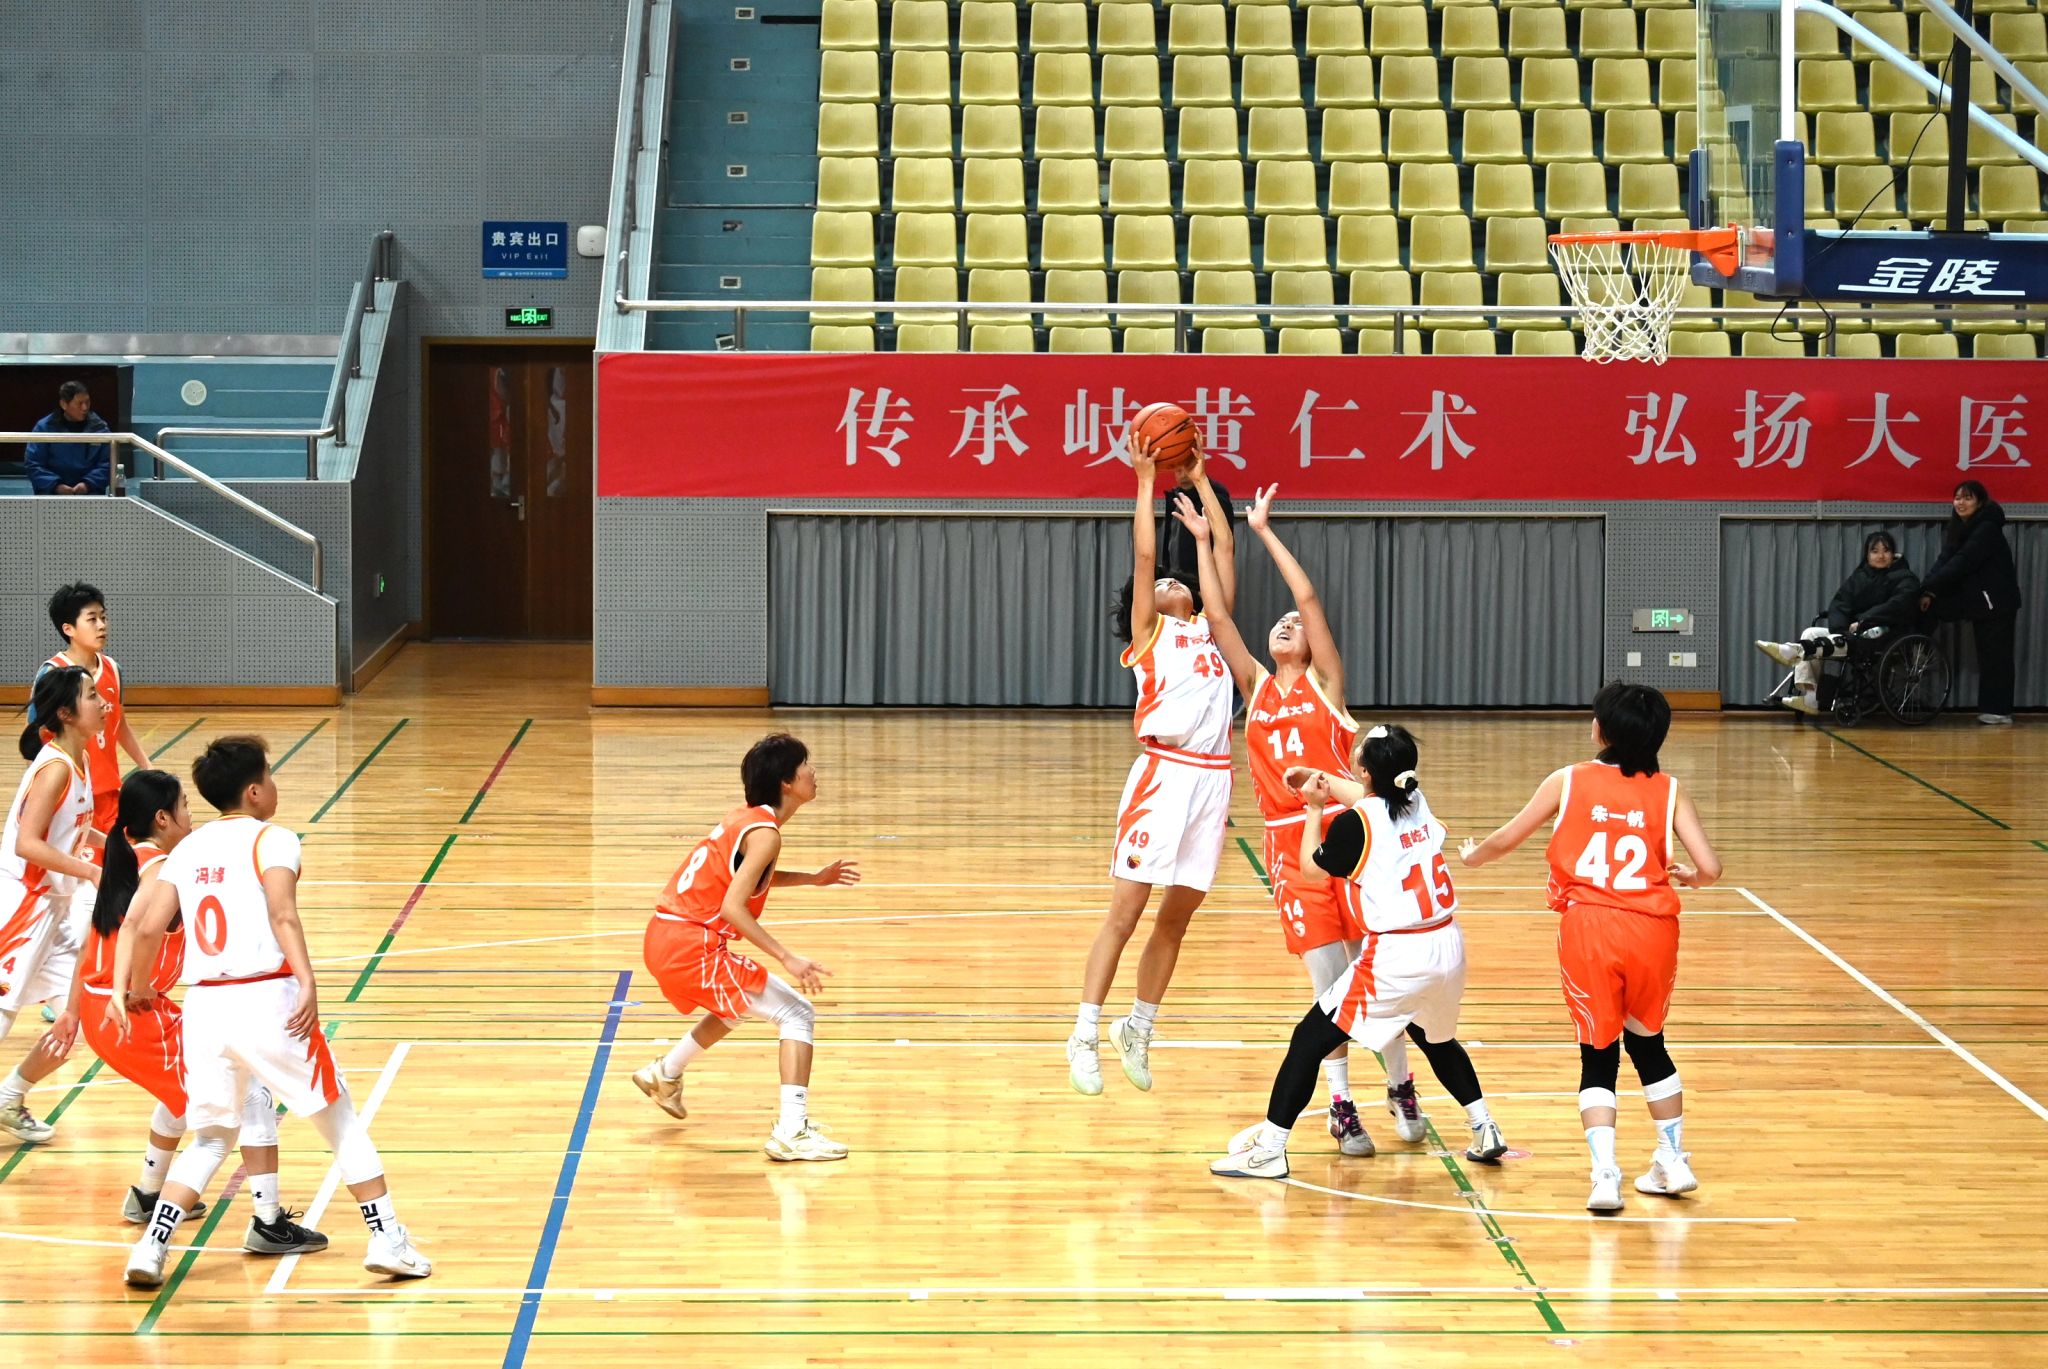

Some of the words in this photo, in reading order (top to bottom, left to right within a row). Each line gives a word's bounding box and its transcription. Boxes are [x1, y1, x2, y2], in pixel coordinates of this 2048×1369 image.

[492, 232, 559, 246] 贵宾出口
[1838, 257, 2026, 296] 金陵
[835, 384, 1478, 470] 传承岐黄仁术
[1625, 389, 2031, 471] 弘扬大医
[1193, 652, 1224, 678] 49
[1267, 727, 1305, 760] 14
[1128, 829, 1150, 849] 49
[677, 846, 708, 894] 8
[1574, 831, 1648, 890] 42
[1401, 852, 1455, 921] 15
[194, 894, 227, 957] 0
[1283, 898, 1304, 921] 14
[2, 956, 17, 975] 4
